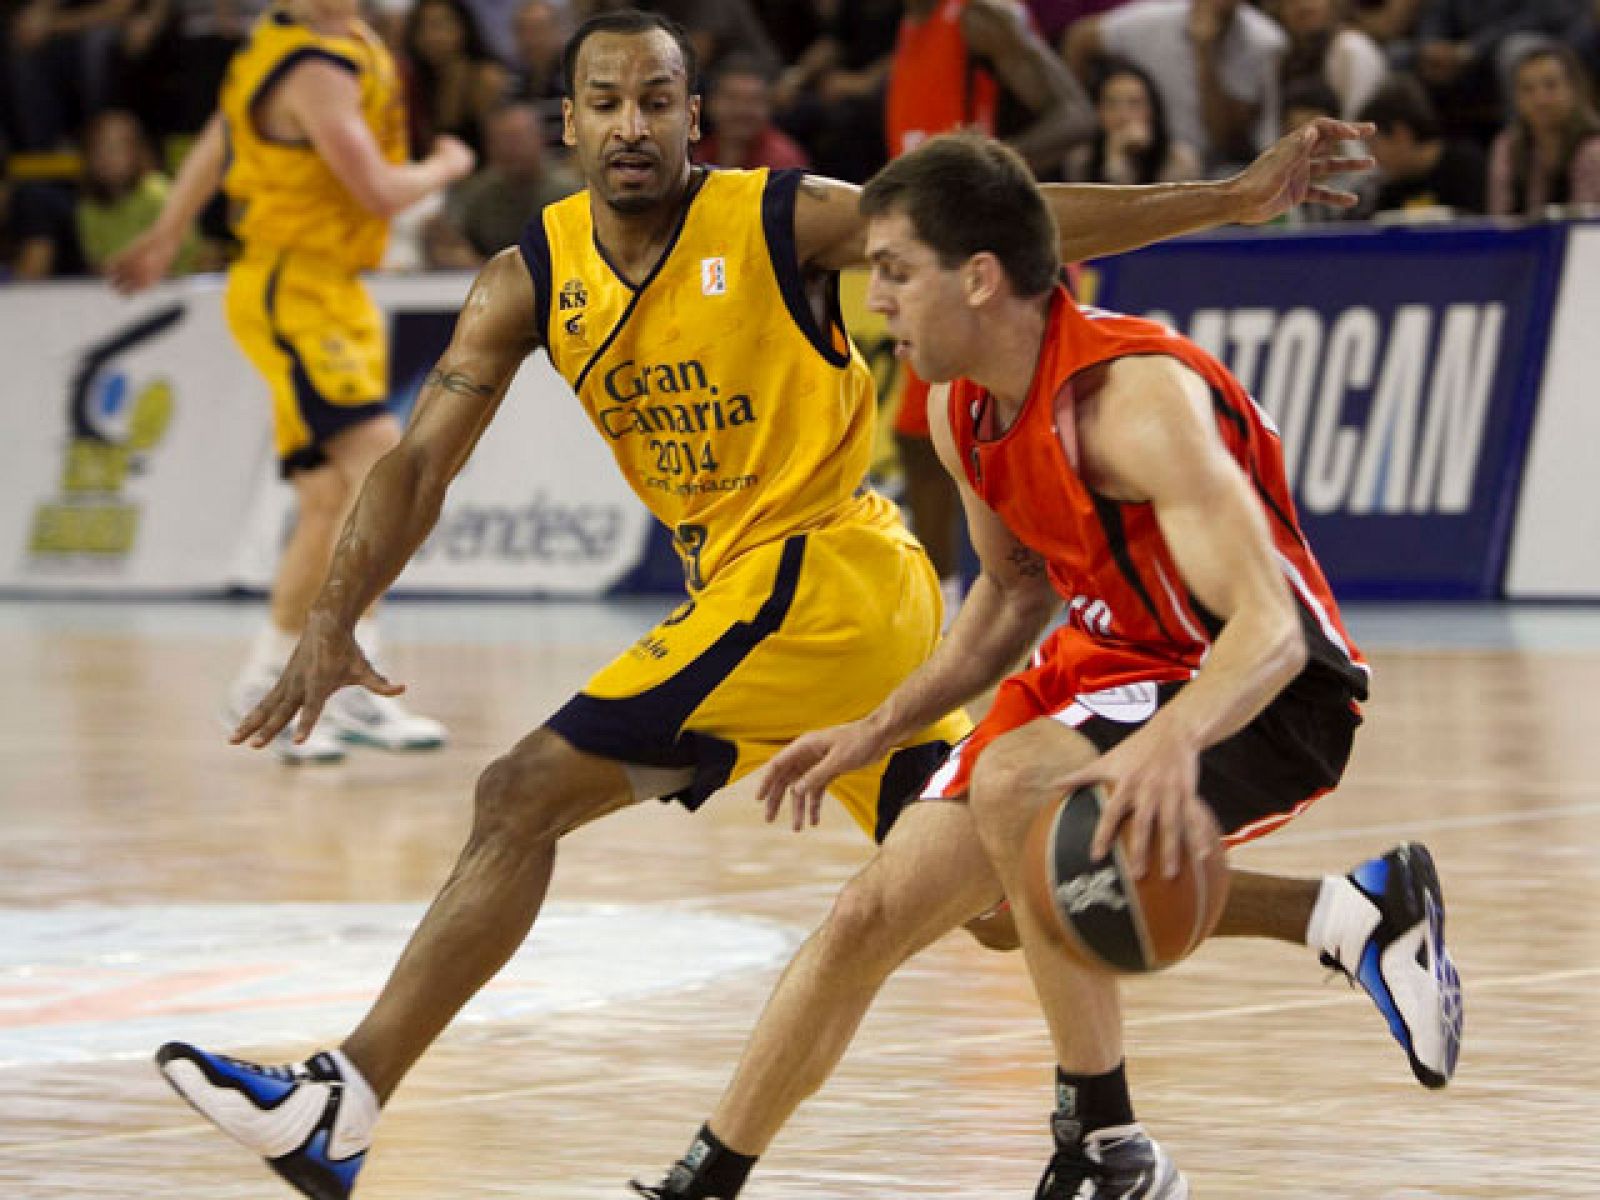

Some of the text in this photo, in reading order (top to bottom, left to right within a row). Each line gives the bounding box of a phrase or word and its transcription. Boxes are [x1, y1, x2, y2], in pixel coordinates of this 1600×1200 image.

[604, 359, 710, 403] Gran
[599, 385, 758, 440] Canaria
[1146, 303, 1506, 515] TOCAN
[650, 440, 719, 476] 2014
